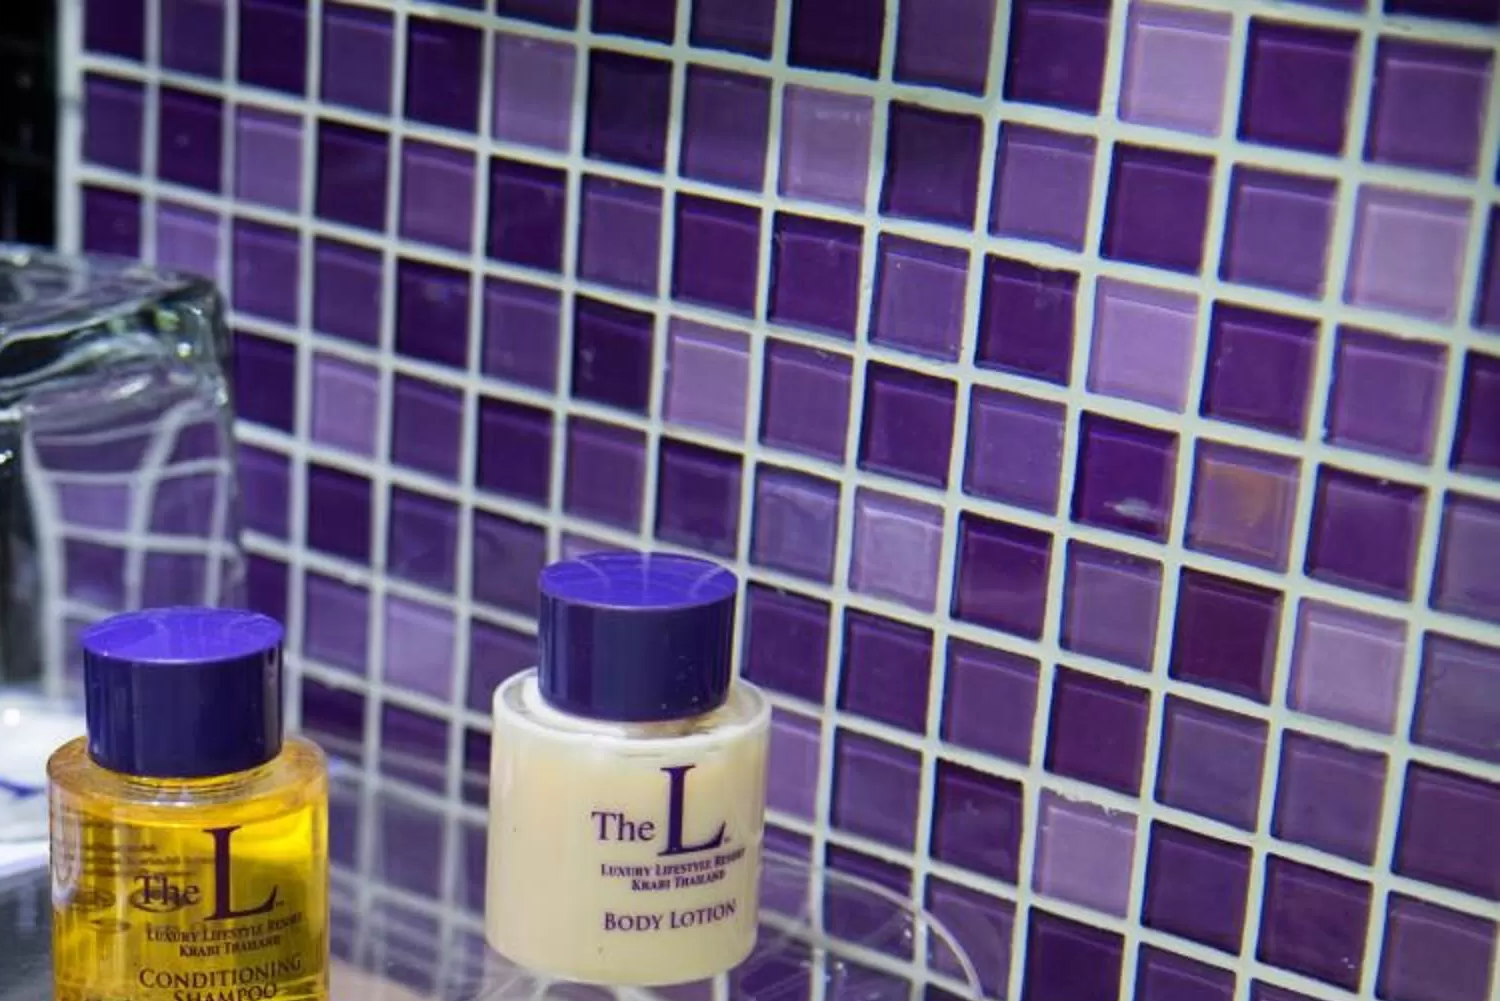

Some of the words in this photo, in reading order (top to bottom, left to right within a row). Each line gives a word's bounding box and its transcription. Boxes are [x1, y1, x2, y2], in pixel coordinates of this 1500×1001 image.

[591, 811, 655, 841] The
[657, 763, 726, 856] L
[133, 874, 201, 906] The
[203, 825, 278, 921] L
[601, 864, 651, 877] LUXURY
[655, 860, 711, 876] LIFESTYLE
[632, 879, 671, 891] KRABI
[674, 869, 726, 889] THAILAND
[605, 911, 663, 931] BODY
[670, 898, 737, 929] LOTION
[139, 954, 301, 989] CONDITIONING
